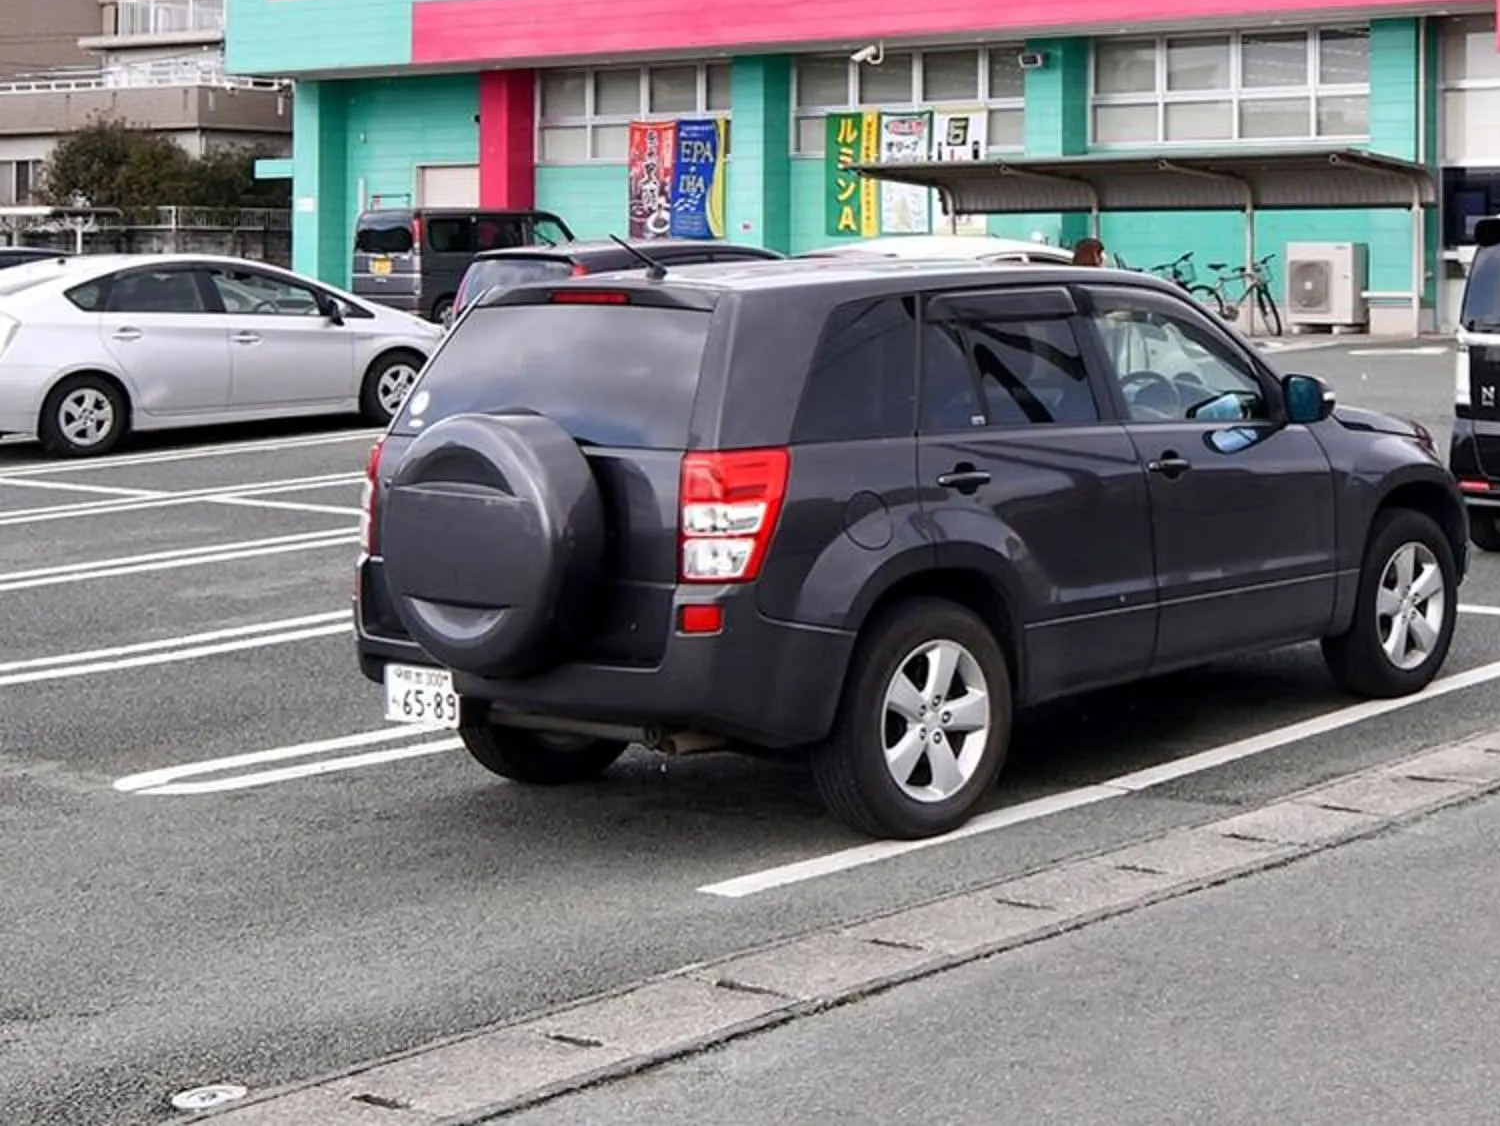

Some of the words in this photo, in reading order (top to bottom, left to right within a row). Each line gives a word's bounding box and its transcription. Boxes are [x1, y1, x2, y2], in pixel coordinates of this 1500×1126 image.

[681, 140, 714, 164] EPA
[837, 117, 858, 233] ルミンA
[403, 689, 457, 721] 65-89
